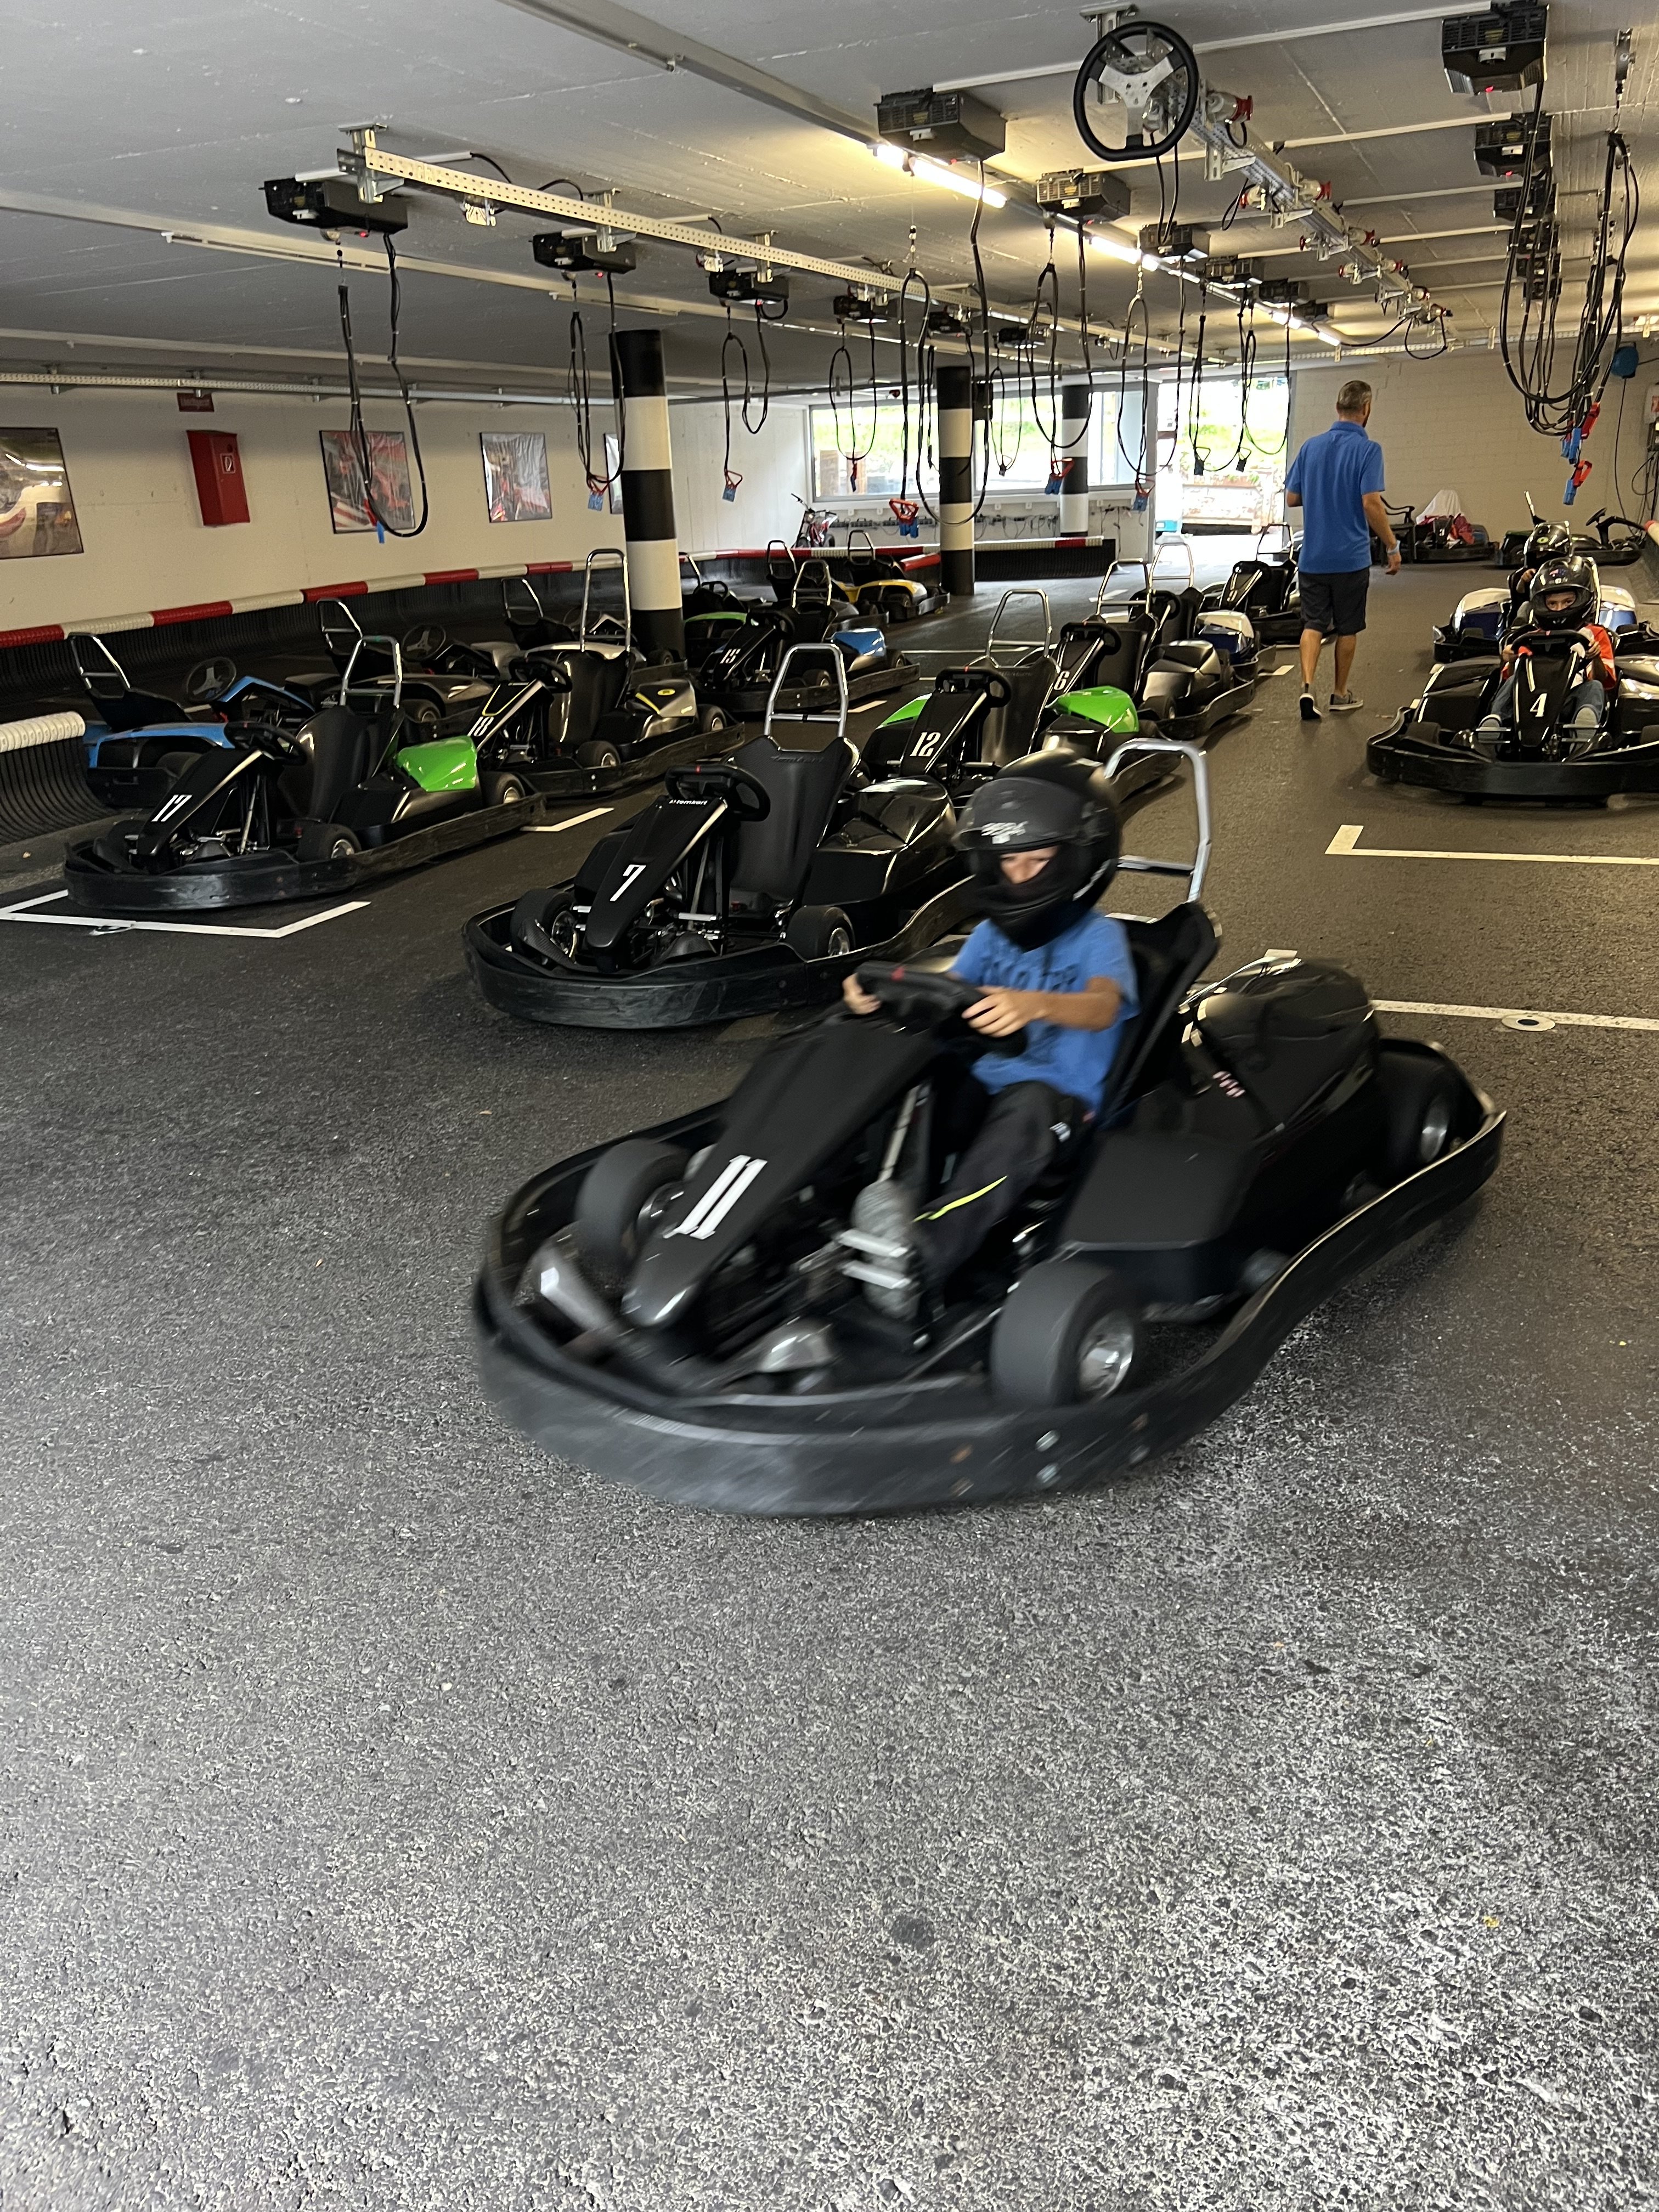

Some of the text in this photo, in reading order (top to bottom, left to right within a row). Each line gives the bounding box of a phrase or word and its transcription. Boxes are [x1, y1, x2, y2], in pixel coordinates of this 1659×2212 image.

[719, 648, 741, 664] 15
[1053, 670, 1070, 690] 6
[1530, 693, 1547, 717] 4
[467, 716, 494, 737] 18
[910, 732, 941, 757] 12
[151, 794, 192, 822] 17
[610, 864, 646, 901] 7
[663, 1154, 768, 1240] 11
